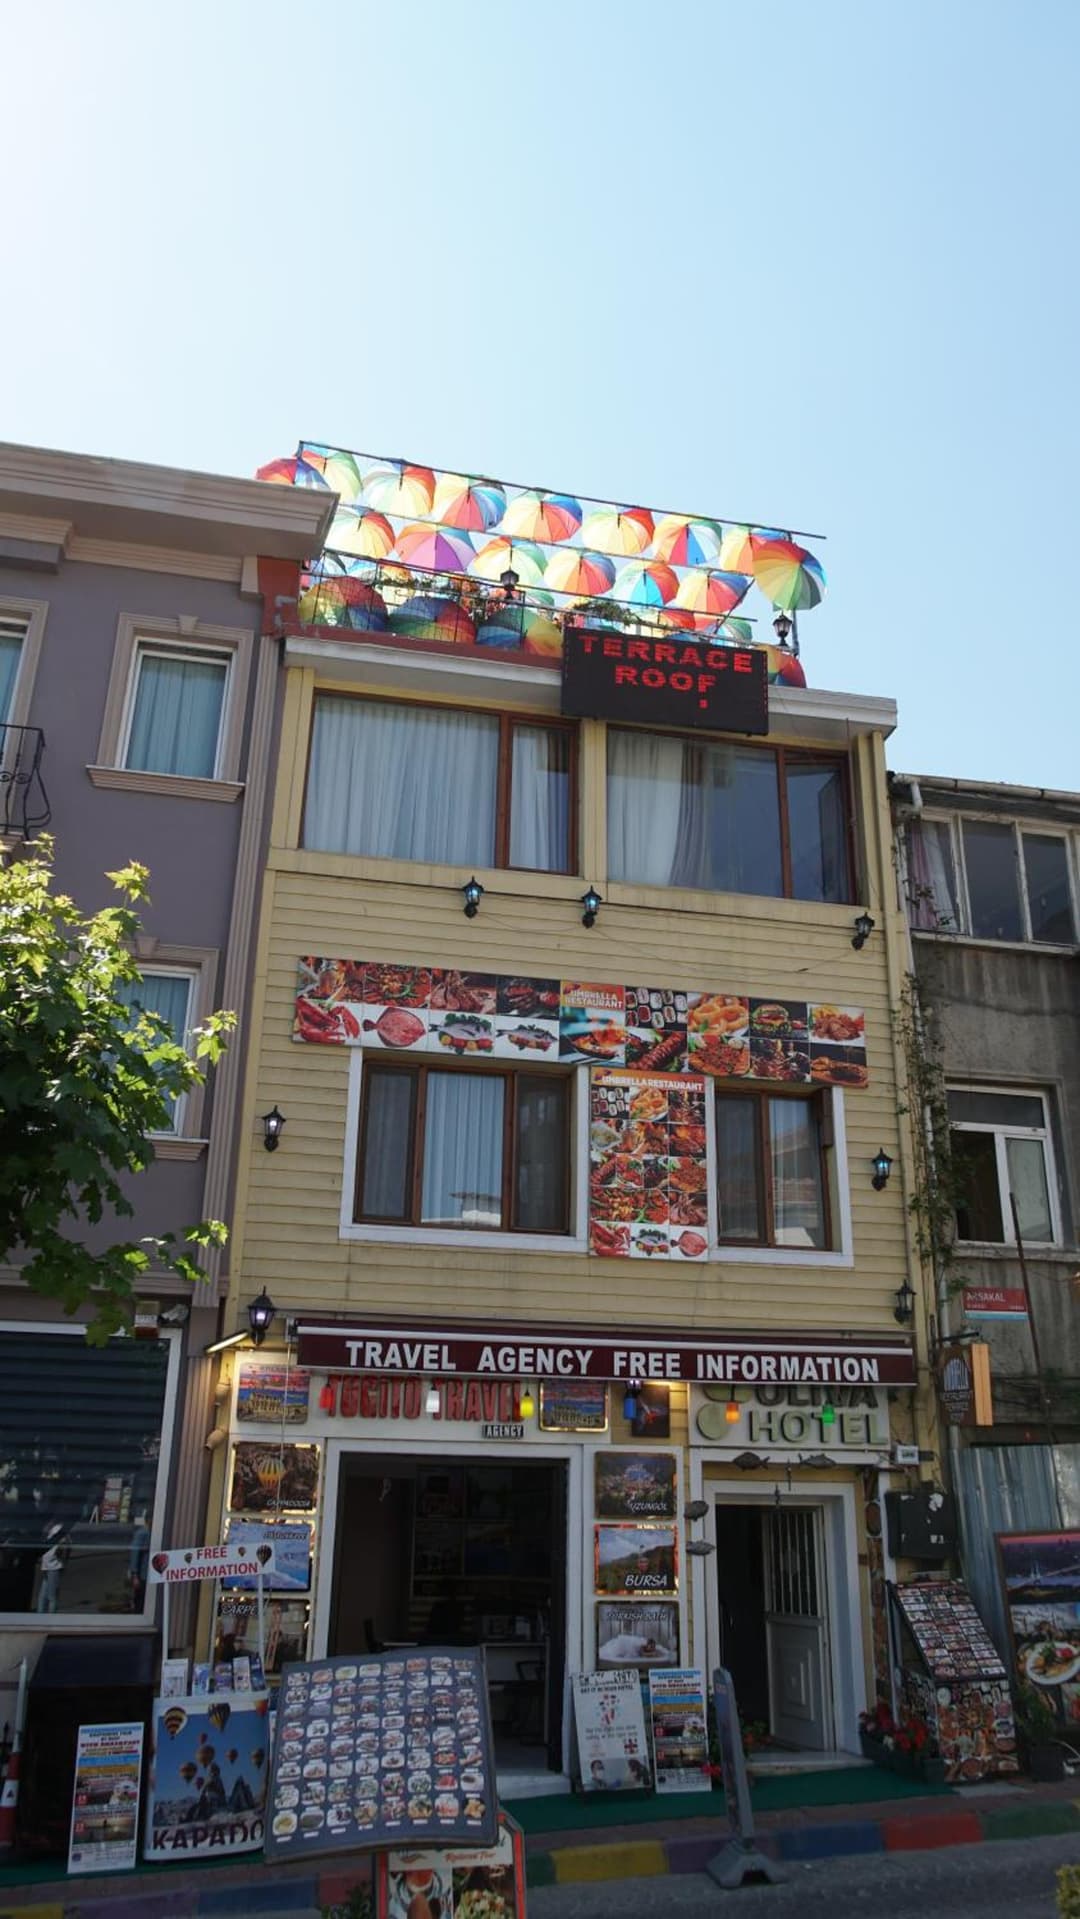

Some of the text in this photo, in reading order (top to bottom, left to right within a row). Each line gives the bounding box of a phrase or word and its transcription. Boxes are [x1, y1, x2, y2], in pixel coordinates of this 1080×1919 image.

[578, 635, 753, 673] TERRACE
[615, 665, 716, 693] ROOF
[566, 998, 624, 1009] RESTAURANT
[570, 989, 618, 1001] UMBRELLA
[602, 1075, 704, 1092] UMBRELLA RESTAURANT
[345, 1341, 879, 1382] TRAVEL AGENCY FREE INFORMATION
[431, 1376, 525, 1423] TRAVEL
[486, 1425, 523, 1438] AGENCY
[750, 1410, 888, 1445] HOTEL
[196, 1546, 228, 1560] FREE
[166, 1562, 258, 1580] INFORMATION
[625, 1574, 668, 1587] BURSA
